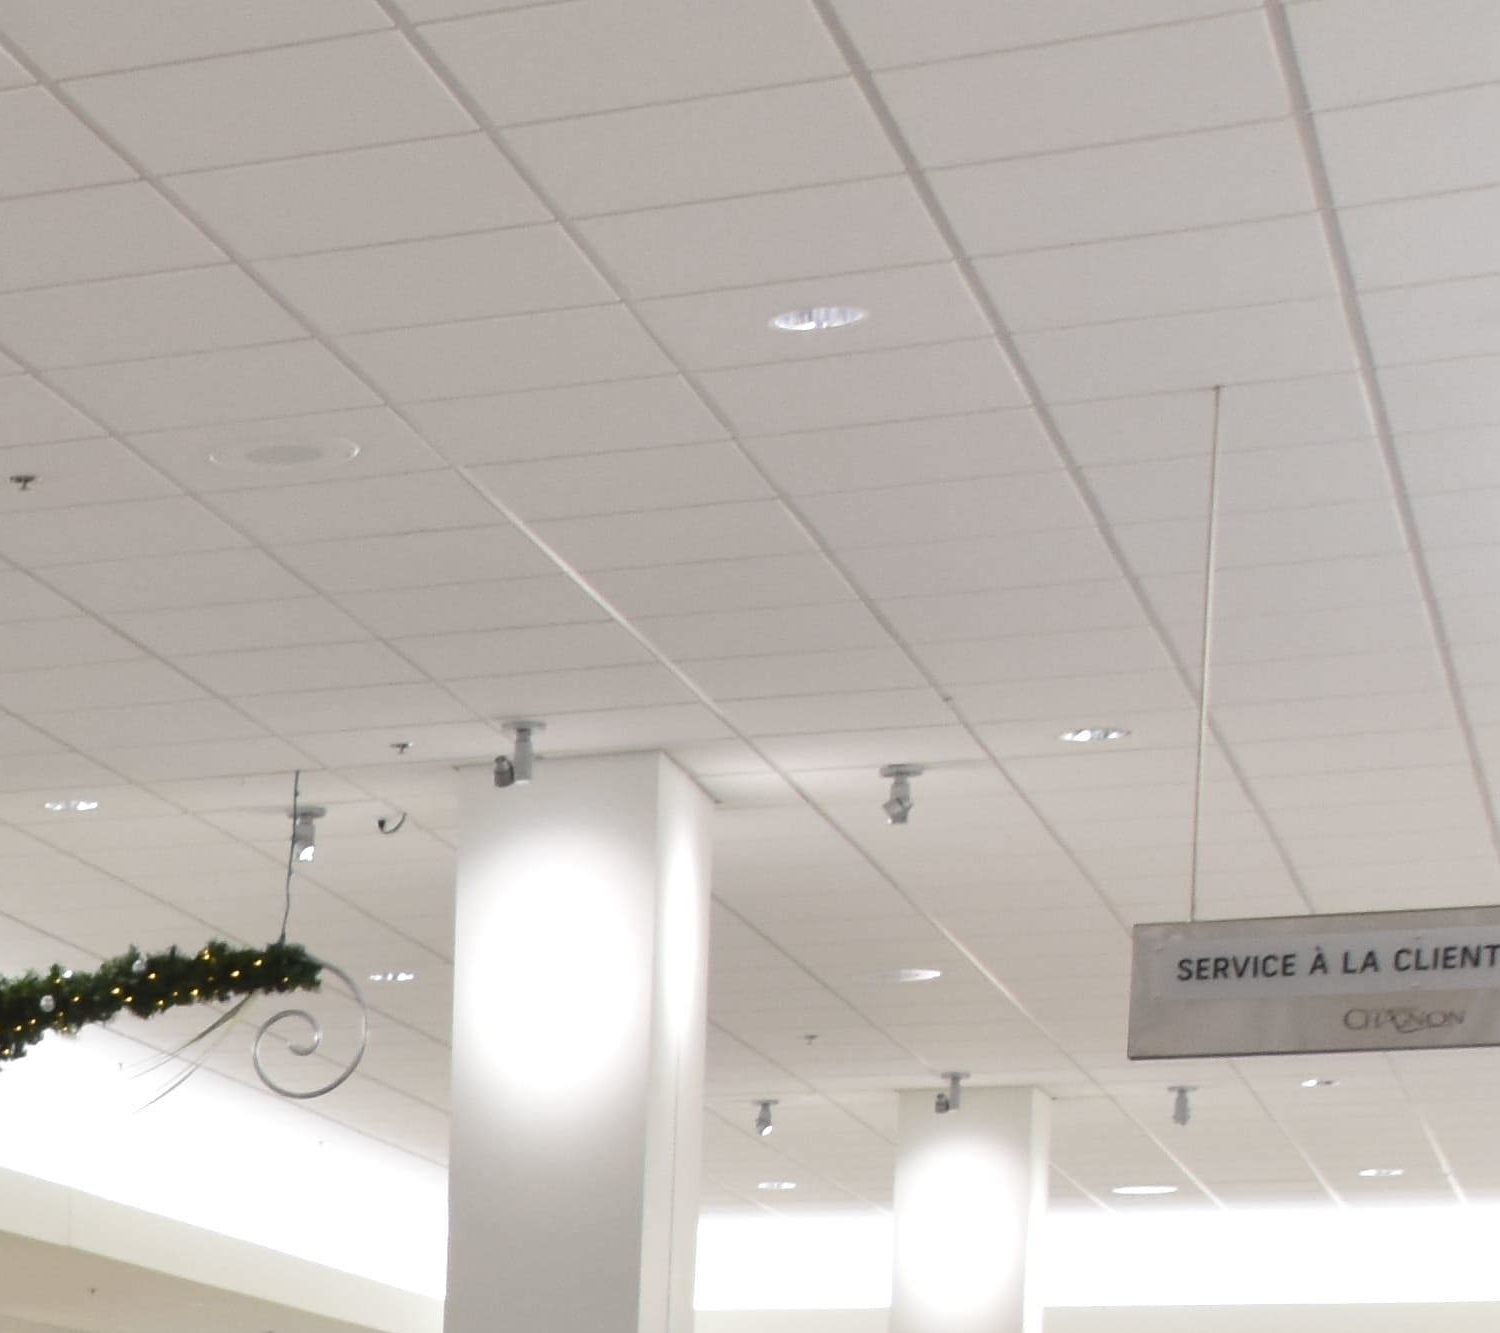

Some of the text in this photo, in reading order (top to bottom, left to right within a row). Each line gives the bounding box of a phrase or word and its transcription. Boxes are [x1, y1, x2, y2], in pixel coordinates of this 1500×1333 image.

[1177, 953, 1296, 982] SERVICE
[1309, 946, 1329, 975] À
[1342, 950, 1379, 974] LA
